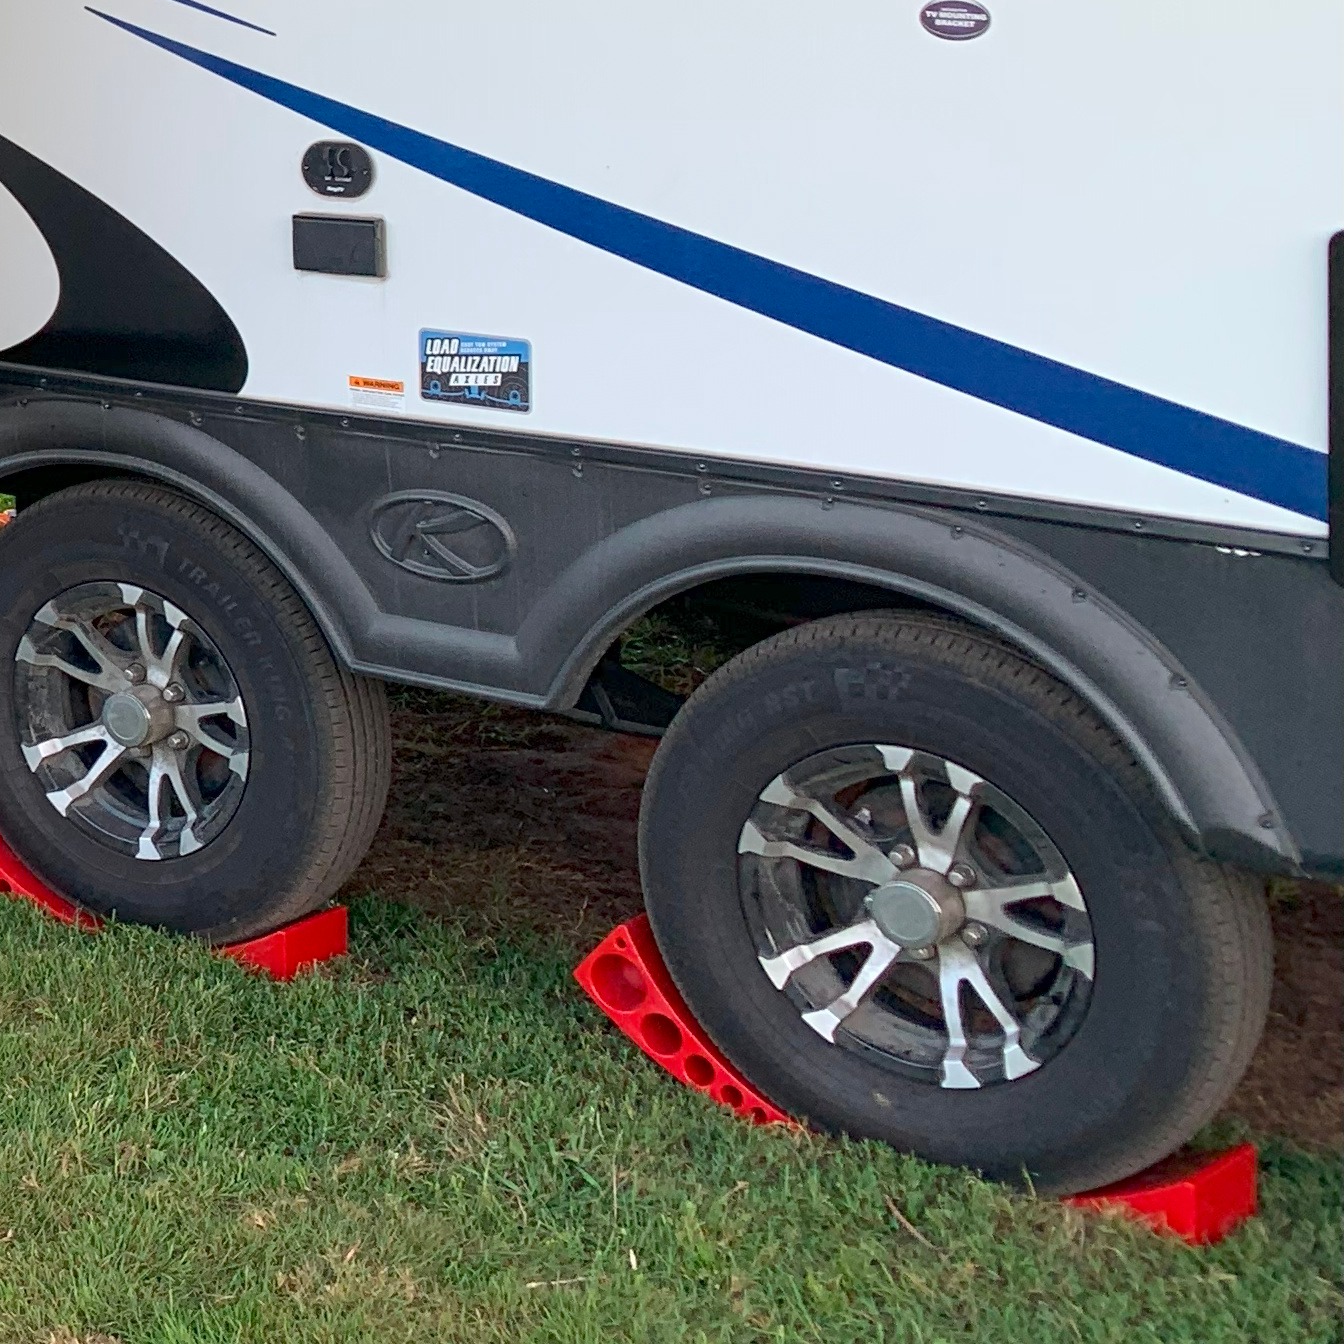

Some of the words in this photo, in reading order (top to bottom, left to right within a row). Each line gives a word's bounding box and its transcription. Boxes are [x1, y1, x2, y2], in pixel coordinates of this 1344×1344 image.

[425, 338, 460, 355] LOAD
[426, 355, 520, 375] EQUALIZATION
[452, 375, 500, 385] AXLES
